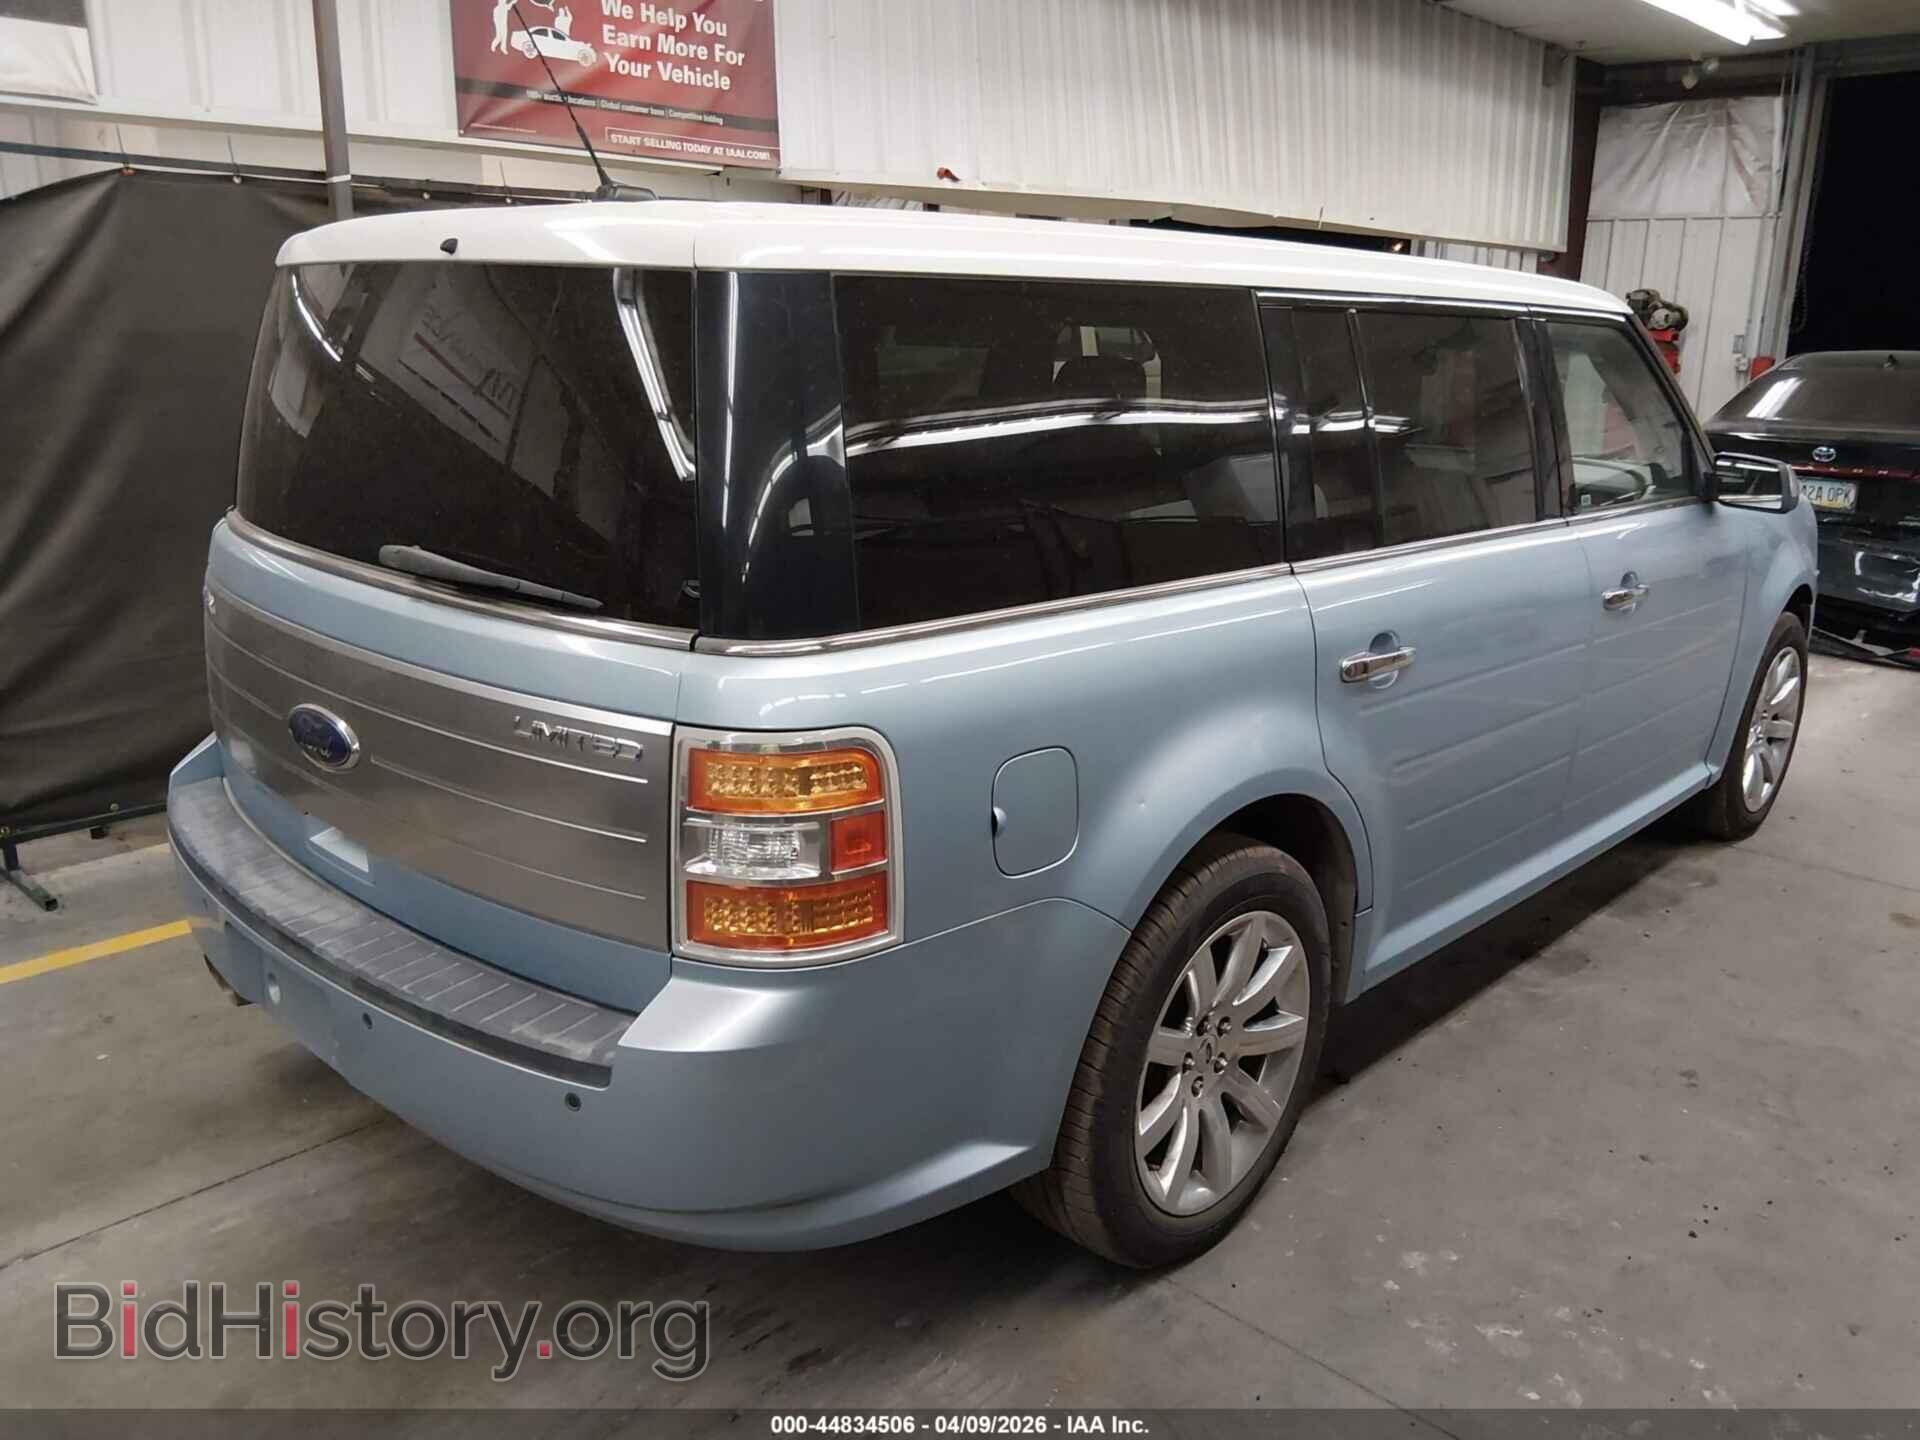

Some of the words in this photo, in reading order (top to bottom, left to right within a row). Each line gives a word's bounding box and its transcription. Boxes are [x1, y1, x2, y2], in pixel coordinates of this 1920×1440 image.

[602, 0, 634, 19] We
[640, 3, 687, 33] Help
[691, 12, 728, 37] You
[602, 24, 652, 50] Earn
[657, 33, 709, 60] More
[714, 44, 745, 66] For
[604, 52, 652, 79] Your
[657, 61, 731, 90] Vehicle
[610, 133, 642, 146] START
[644, 137, 682, 151] SELLING
[682, 142, 712, 155] TODAY
[713, 147, 725, 156] AT
[513, 714, 644, 761] LIMITED
